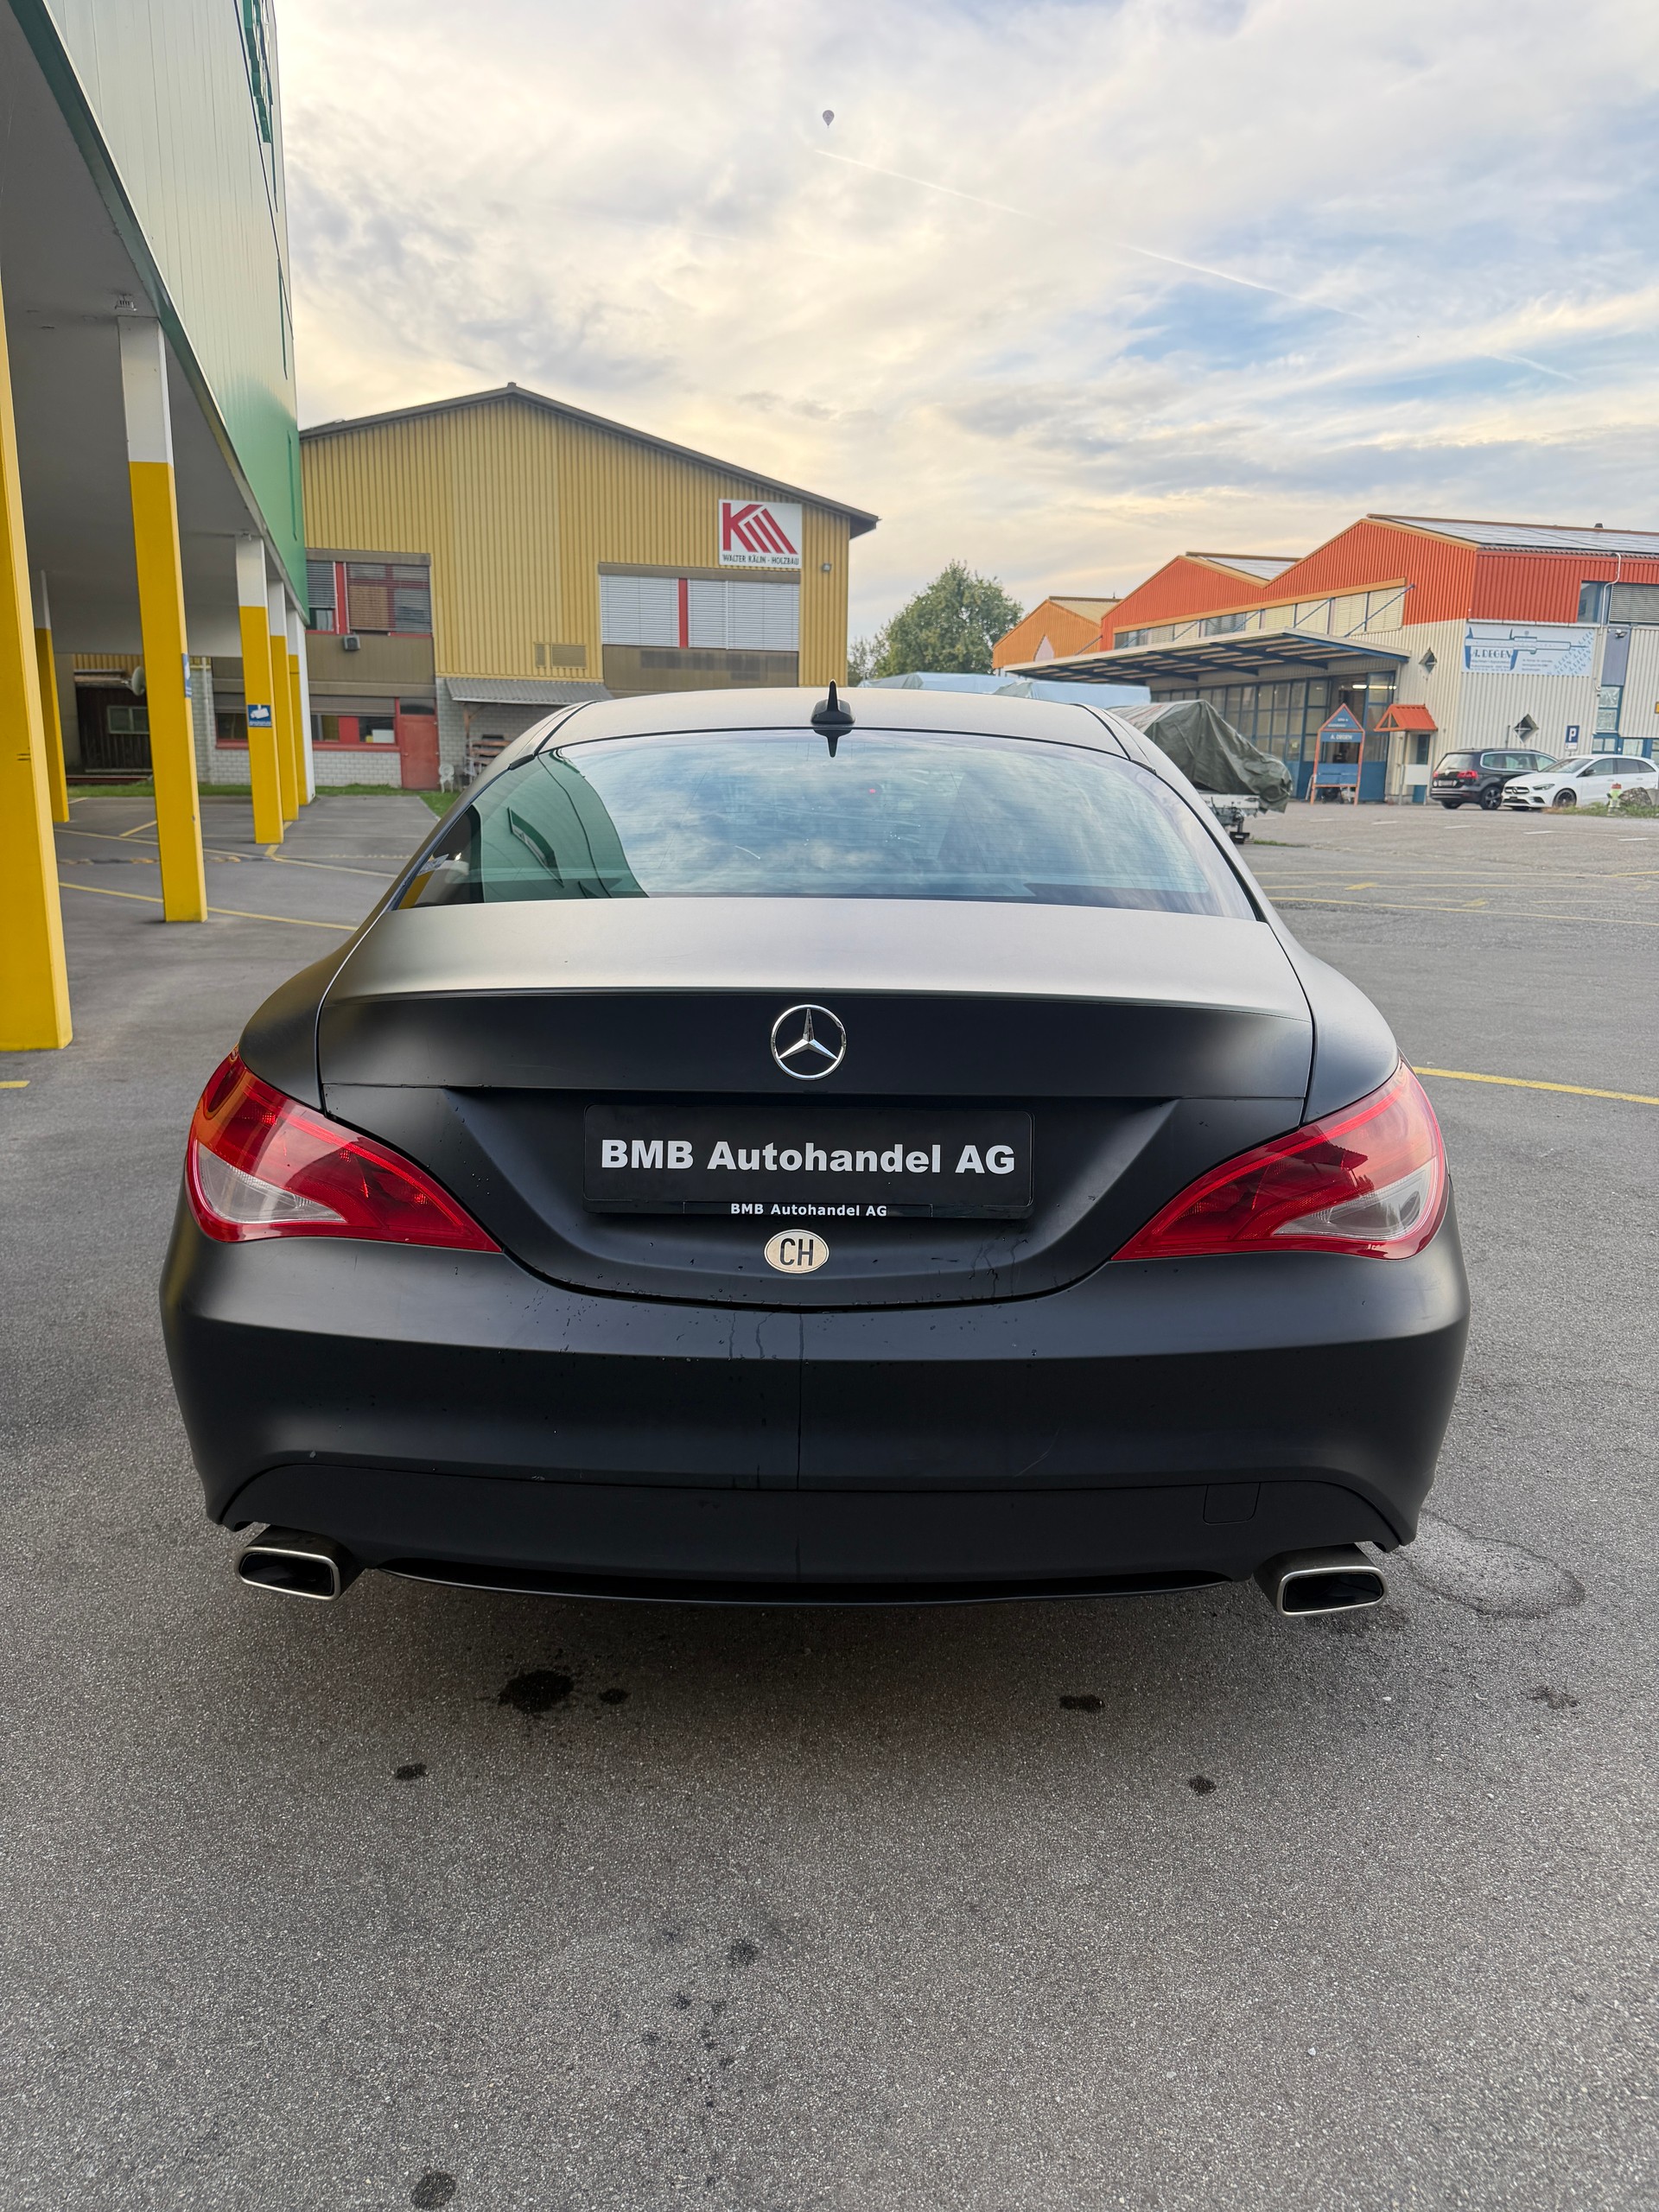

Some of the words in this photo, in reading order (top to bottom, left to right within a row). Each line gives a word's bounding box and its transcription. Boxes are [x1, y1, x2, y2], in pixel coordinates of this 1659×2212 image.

[722, 554, 746, 563] WALTER
[772, 556, 799, 565] HOLZBAU
[1482, 649, 1511, 658] DEGEN
[1568, 728, 1577, 741] P
[601, 1139, 694, 1169] BMB
[707, 1141, 942, 1173] Autohandel
[954, 1145, 1014, 1174] AG
[730, 1204, 764, 1215] BMB
[770, 1204, 860, 1217] Autohandel
[865, 1205, 887, 1217] AG
[779, 1237, 814, 1266] CH
